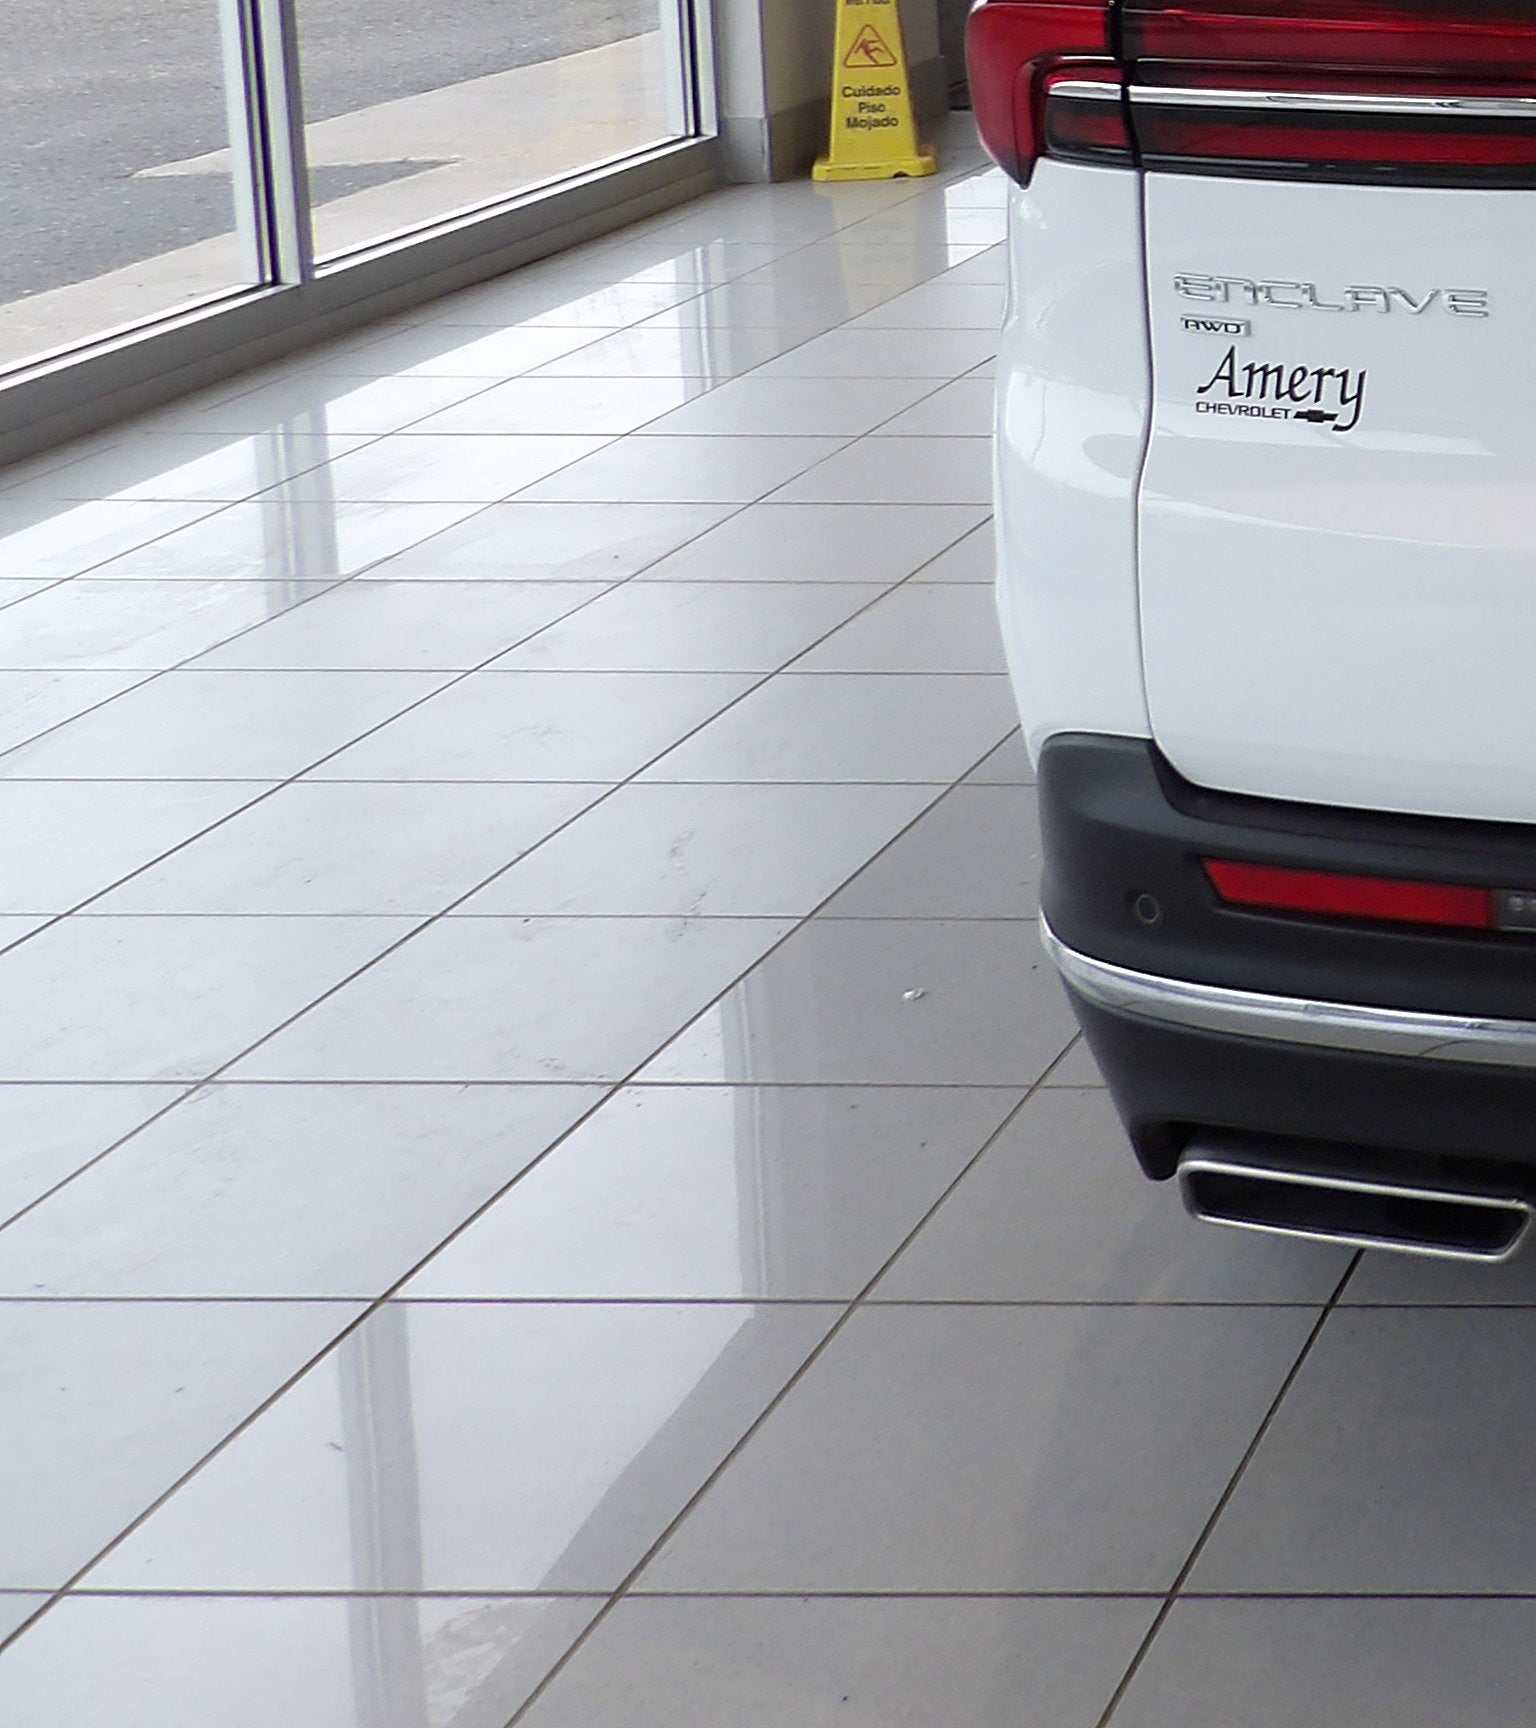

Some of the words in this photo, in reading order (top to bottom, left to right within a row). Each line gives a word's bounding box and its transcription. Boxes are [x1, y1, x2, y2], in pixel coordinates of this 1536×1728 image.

[842, 85, 900, 98] Cuidado
[858, 101, 886, 113] Piso
[846, 115, 899, 131] Mojado
[1173, 272, 1489, 318] ENCLAVE
[1184, 318, 1241, 334] AWD
[1196, 345, 1367, 432] Amery
[1195, 401, 1293, 420] CHEVROLET
